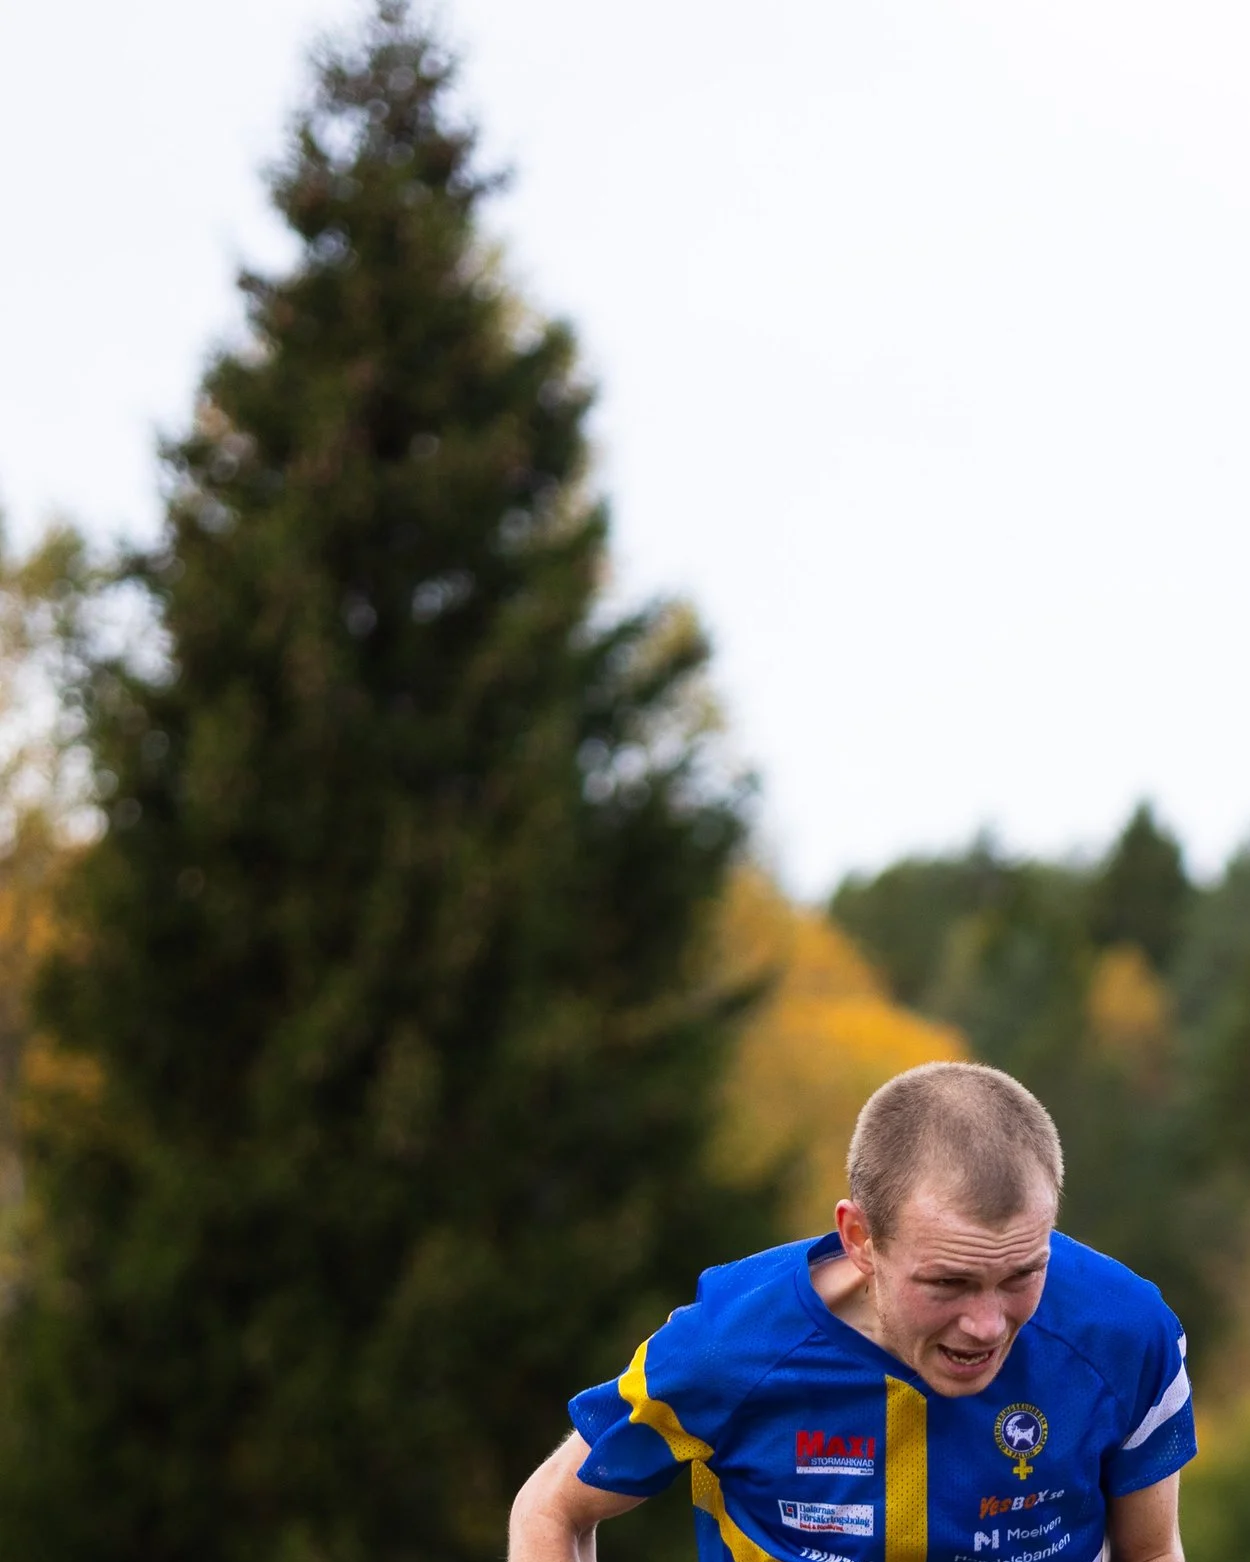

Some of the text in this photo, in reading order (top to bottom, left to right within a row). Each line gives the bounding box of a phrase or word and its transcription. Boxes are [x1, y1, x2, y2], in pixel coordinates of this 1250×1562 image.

[796, 1430, 876, 1459] MAXI
[811, 1457, 874, 1468] STORMARKNAD
[1007, 1516, 1062, 1541] Moelven
